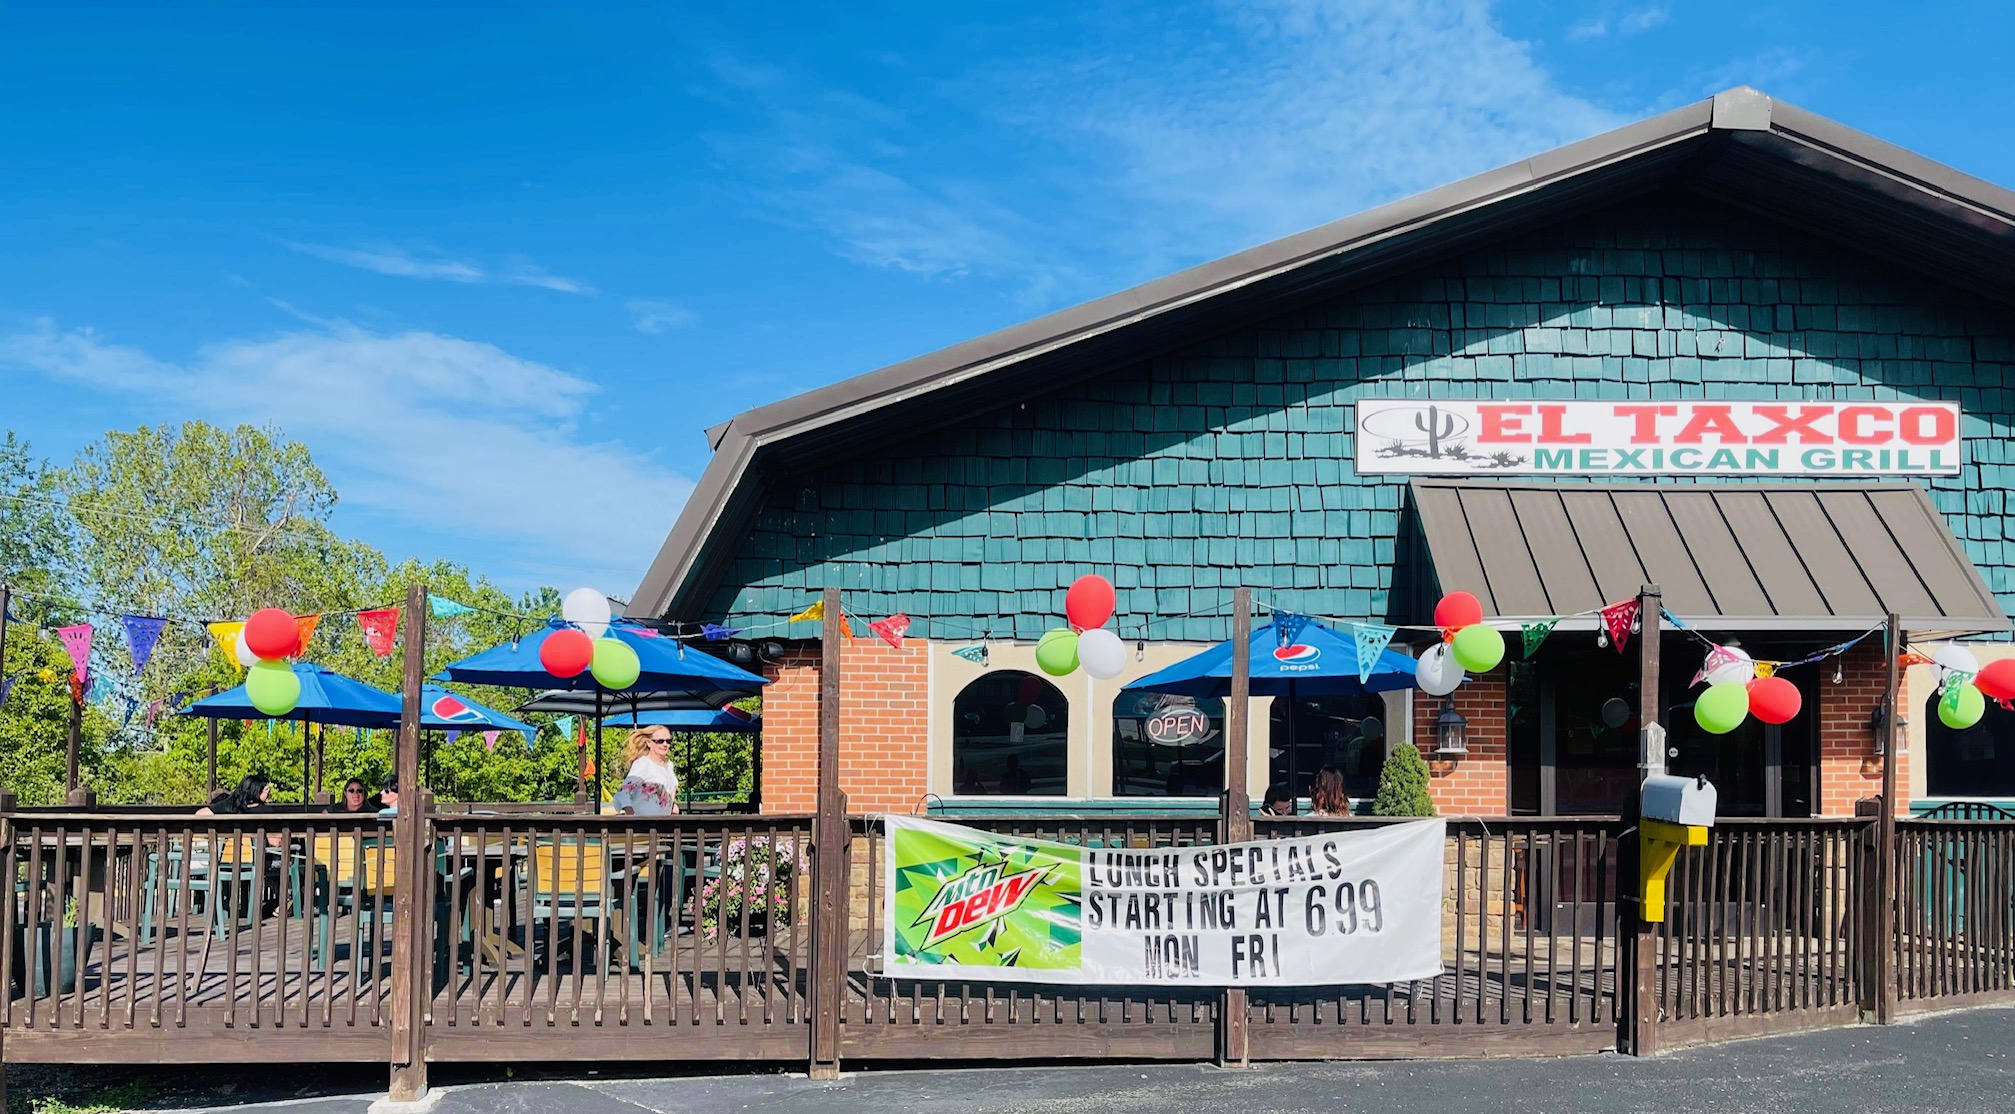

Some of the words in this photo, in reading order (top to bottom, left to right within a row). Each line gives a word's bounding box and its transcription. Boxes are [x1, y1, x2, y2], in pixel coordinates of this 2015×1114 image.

[1477, 405, 1592, 444] EL
[1613, 405, 1956, 446] TAXCO
[1535, 449, 1778, 469] MEXICAN
[1801, 449, 1957, 470] GRILL
[1280, 663, 1319, 672] pepsi
[1148, 714, 1204, 738] OPEN
[1089, 851, 1180, 888] LUNCH
[1193, 841, 1342, 887] SPECIALS
[1089, 890, 1235, 929] STARTING
[1255, 887, 1290, 929] AT
[1145, 934, 1199, 979] MON
[1232, 934, 1280, 978] FRI
